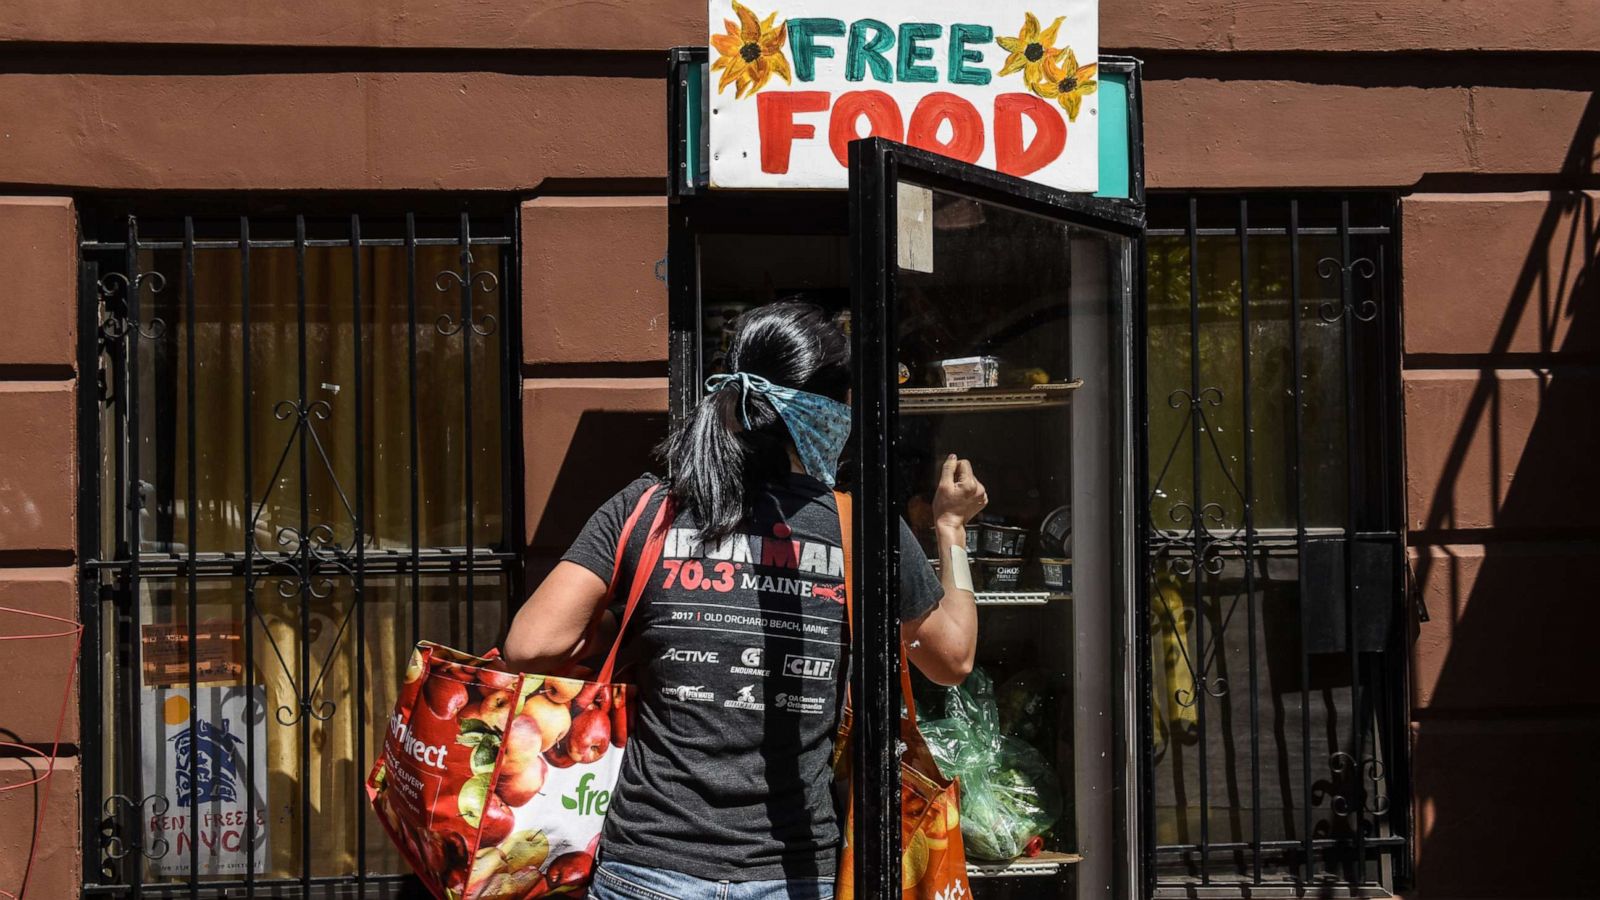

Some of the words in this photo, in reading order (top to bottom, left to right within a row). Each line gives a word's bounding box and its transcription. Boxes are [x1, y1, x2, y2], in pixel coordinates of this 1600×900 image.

[786, 18, 993, 84] FREE
[757, 89, 1067, 177] FOOD
[662, 559, 736, 592] 70.3
[740, 572, 812, 598] MAINE
[671, 611, 694, 621] 2017
[704, 612, 723, 622] OLD
[724, 613, 768, 627] ORCHARD
[769, 618, 801, 632] BEACH,
[802, 624, 829, 635] MAINE
[730, 666, 770, 677] ENDURANCE
[790, 658, 831, 678] CLIF
[397, 767, 425, 791] ELIVERY
[150, 815, 190, 832] REN
[204, 810, 265, 827] FREEE
[177, 831, 240, 857] NYC
